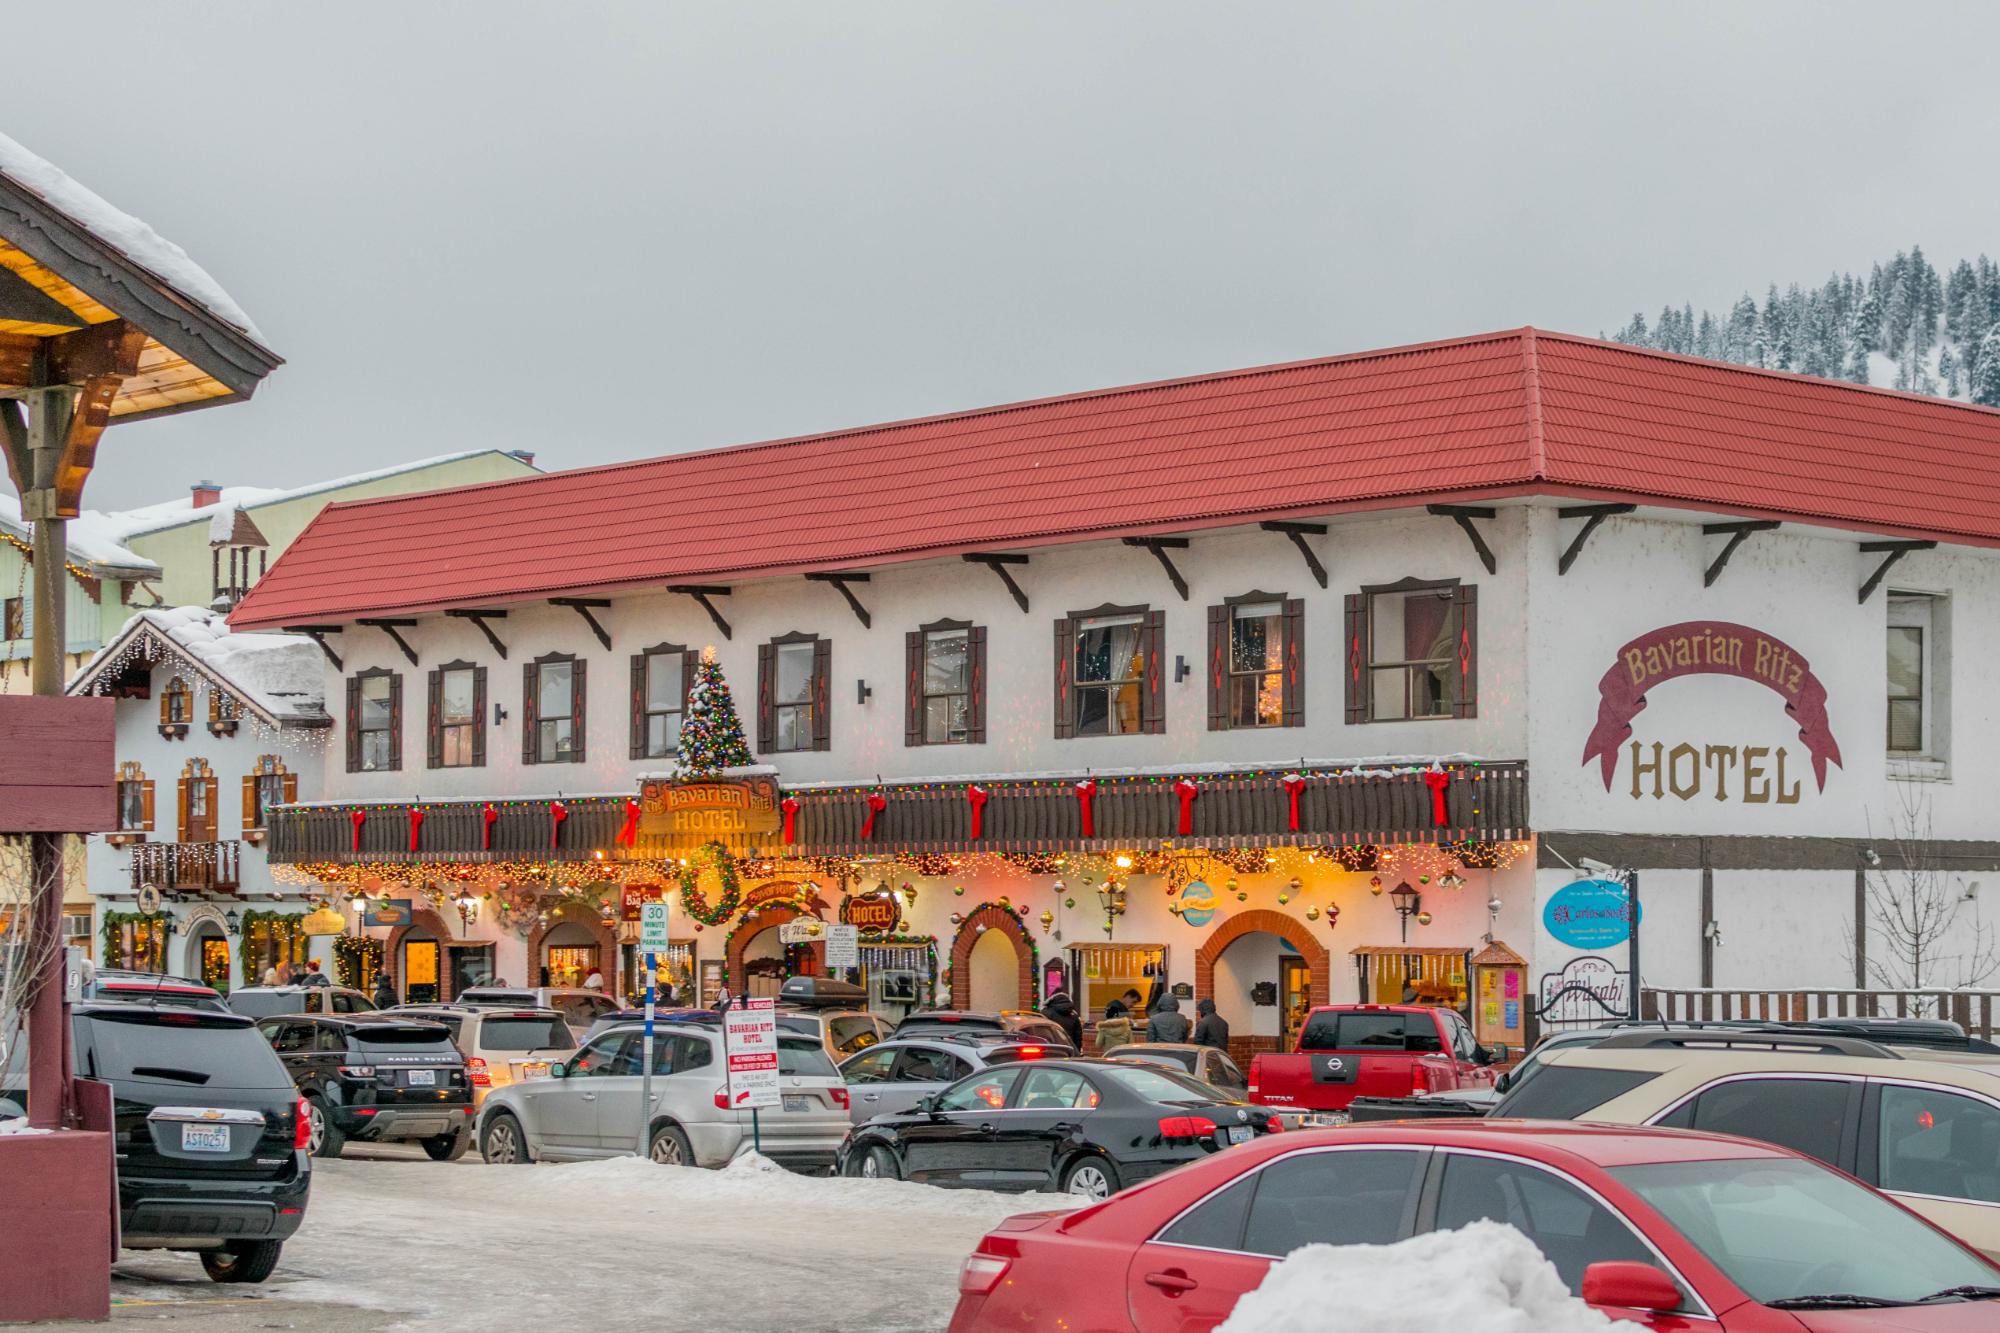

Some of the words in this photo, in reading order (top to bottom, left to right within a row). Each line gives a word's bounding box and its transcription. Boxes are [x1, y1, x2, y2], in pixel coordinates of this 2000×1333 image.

[1625, 628, 1743, 686] Bavarian
[1754, 637, 1804, 694] Ritz
[1629, 739, 1801, 804] HOTEL
[670, 786, 742, 807] Bavarian
[751, 795, 771, 810] Ritz
[674, 809, 745, 829] HOTEL
[625, 894, 642, 908] Bag
[648, 907, 663, 919] 30
[852, 905, 891, 924] HOTEL
[644, 921, 665, 929] MINUTE
[642, 938, 667, 946] PARKING
[1565, 977, 1625, 1003] Wasabi
[729, 1024, 758, 1033] BAVARIAN
[744, 1034, 762, 1043] HOTEL
